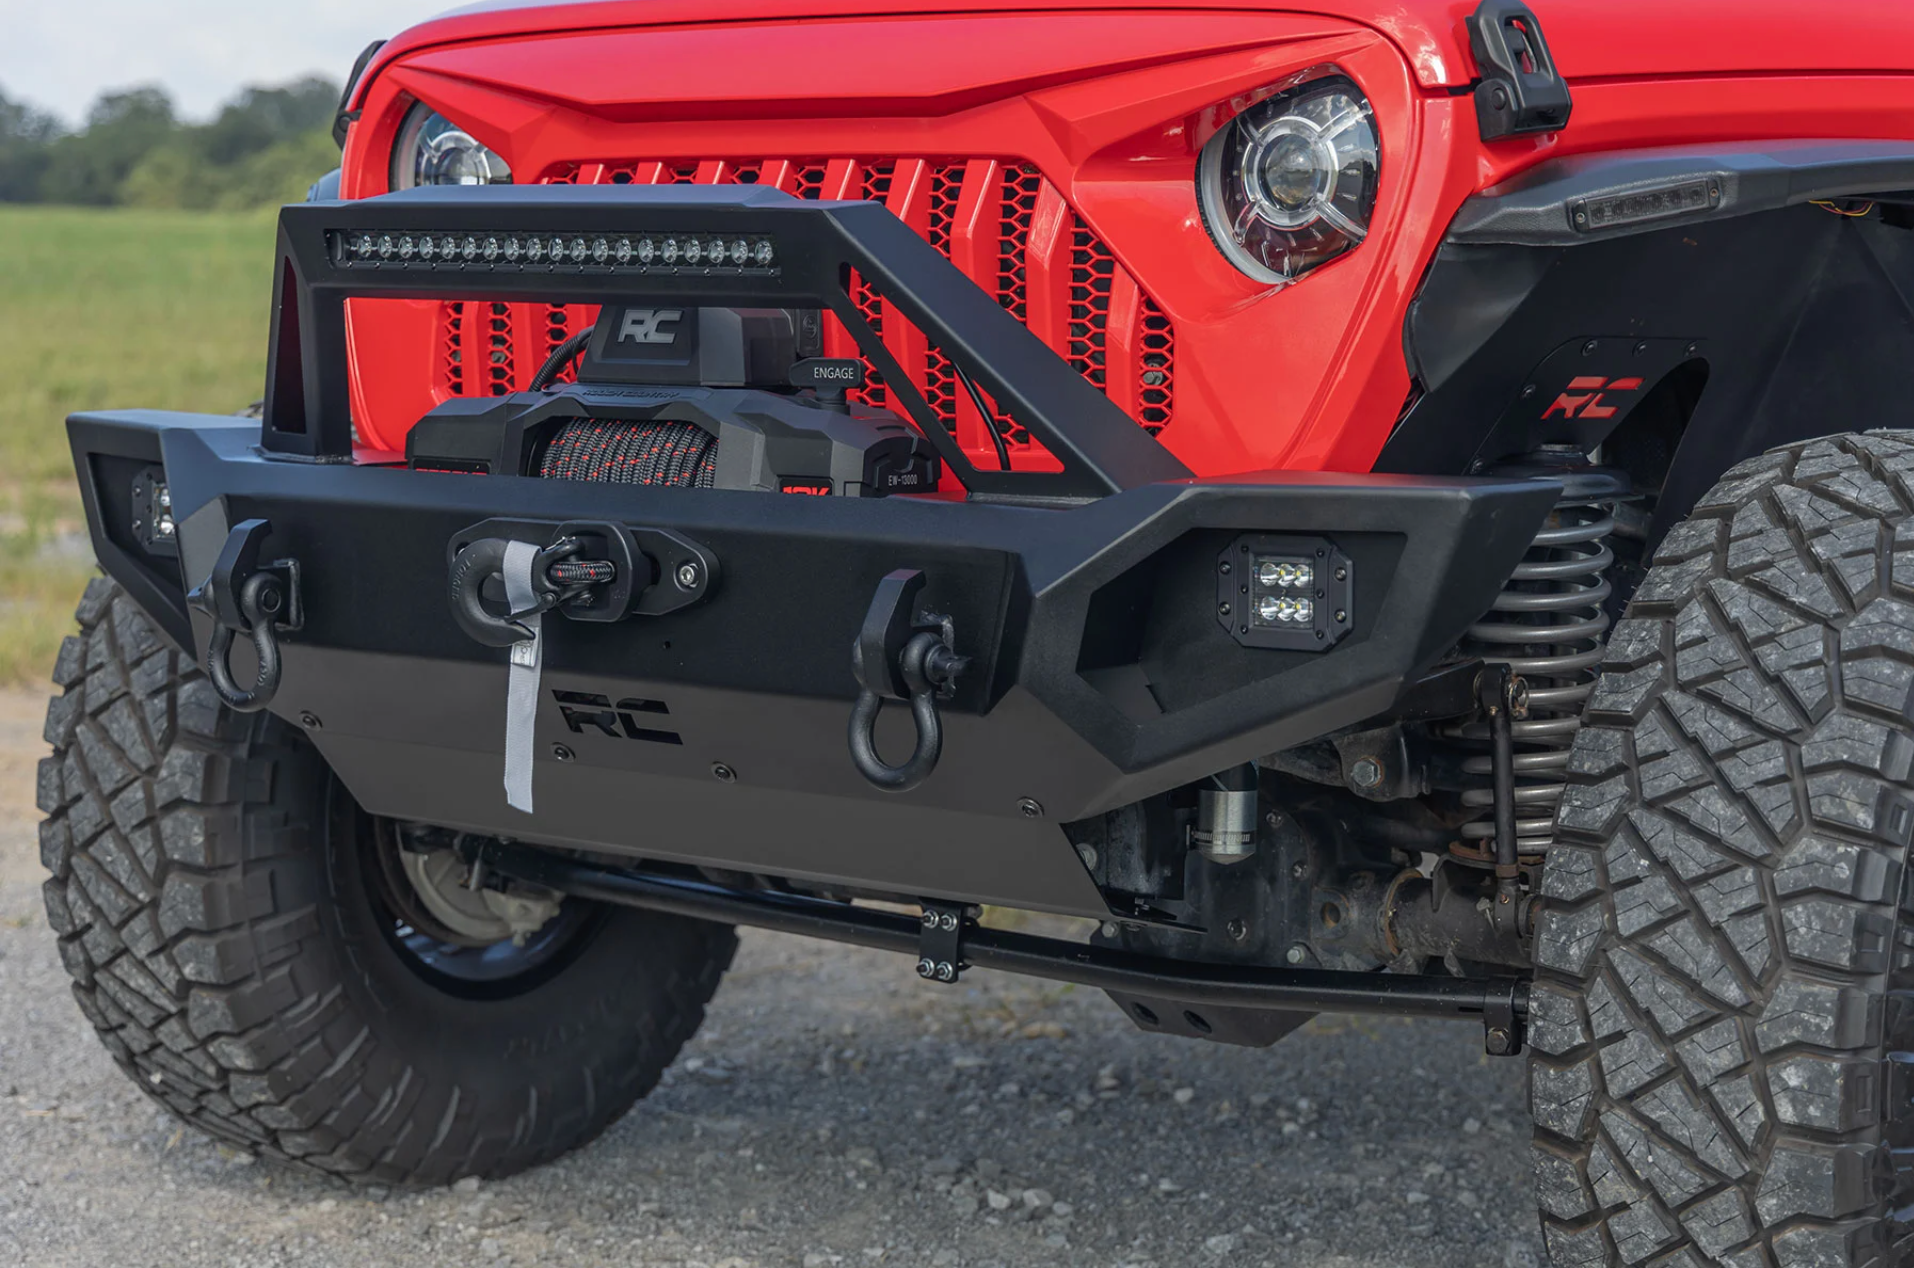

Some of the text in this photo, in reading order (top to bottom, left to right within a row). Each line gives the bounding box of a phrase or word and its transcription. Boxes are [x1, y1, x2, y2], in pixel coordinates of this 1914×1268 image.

[617, 309, 684, 344] RC
[813, 366, 855, 379] ENGAGE
[887, 473, 918, 486] EW-13000
[551, 689, 683, 745] RC
